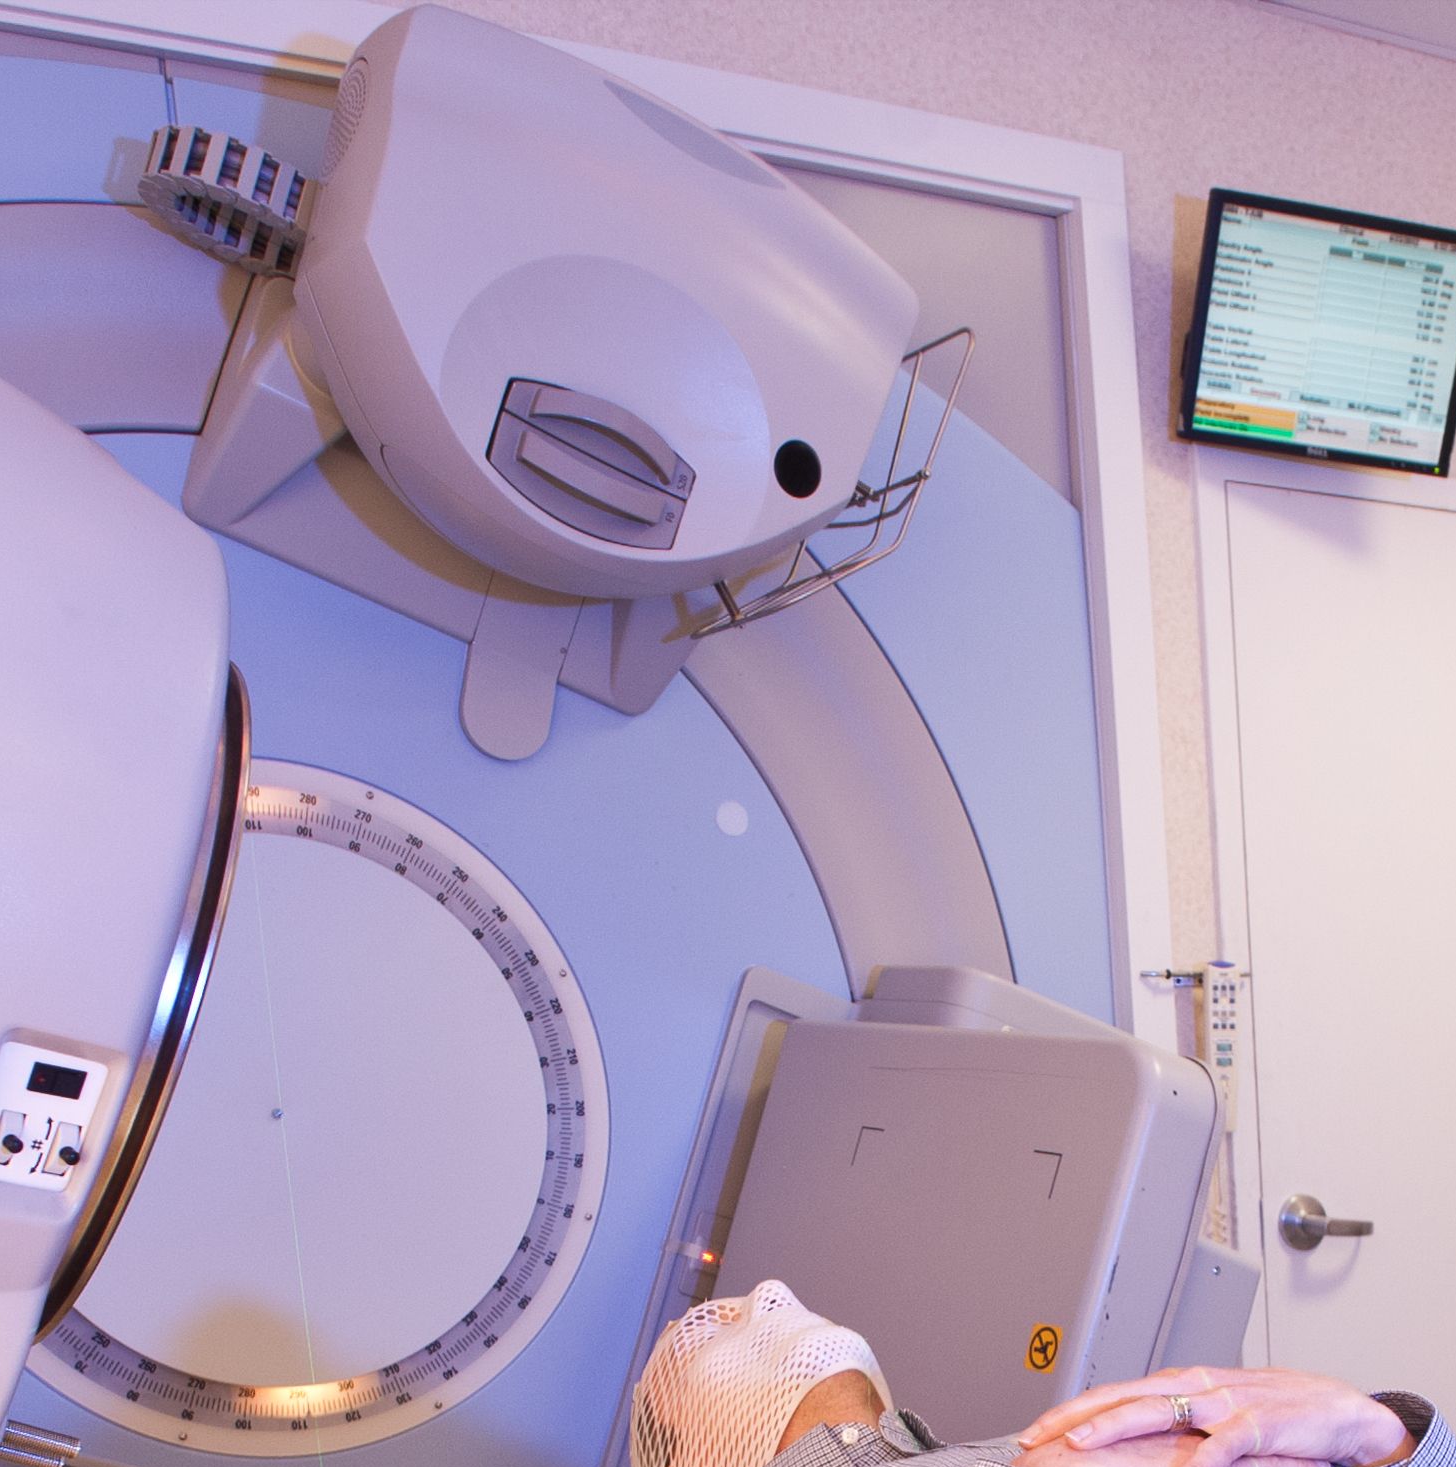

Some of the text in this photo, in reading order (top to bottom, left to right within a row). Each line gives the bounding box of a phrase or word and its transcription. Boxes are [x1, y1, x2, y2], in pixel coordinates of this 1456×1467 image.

[299, 793, 317, 806] 280
[354, 809, 372, 824] 270
[245, 820, 263, 831] 110
[297, 825, 313, 838] 100
[349, 840, 361, 853] 90
[405, 834, 423, 850] 260
[395, 862, 407, 876] 80
[451, 866, 469, 883] 250
[436, 892, 450, 906] 70
[491, 906, 509, 923] 240
[471, 928, 485, 941] 60
[524, 948, 540, 968] 230
[501, 967, 513, 980] 50
[549, 997, 563, 1016] 220
[523, 1010, 535, 1022] 40
[566, 1048, 579, 1066] 210
[547, 1102, 555, 1116] 20
[575, 1100, 585, 1118] 200
[546, 1150, 555, 1161] 10
[544, 1251, 557, 1268] 170
[517, 1294, 532, 1310] 160
[91, 1331, 111, 1348] 250
[483, 1334, 499, 1349] 150
[425, 1340, 442, 1356] 320
[75, 1360, 89, 1374] 70
[137, 1358, 157, 1374] 260
[383, 1362, 400, 1378] 310
[443, 1366, 459, 1381] 140
[187, 1377, 207, 1390] 270
[337, 1380, 355, 1392] 300
[126, 1390, 141, 1402] 80
[238, 1387, 256, 1399] 280
[396, 1392, 412, 1406] 130
[181, 1408, 194, 1421] 90
[345, 1410, 362, 1423] 120
[235, 1418, 252, 1430] 100
[291, 1420, 308, 1430] 110
